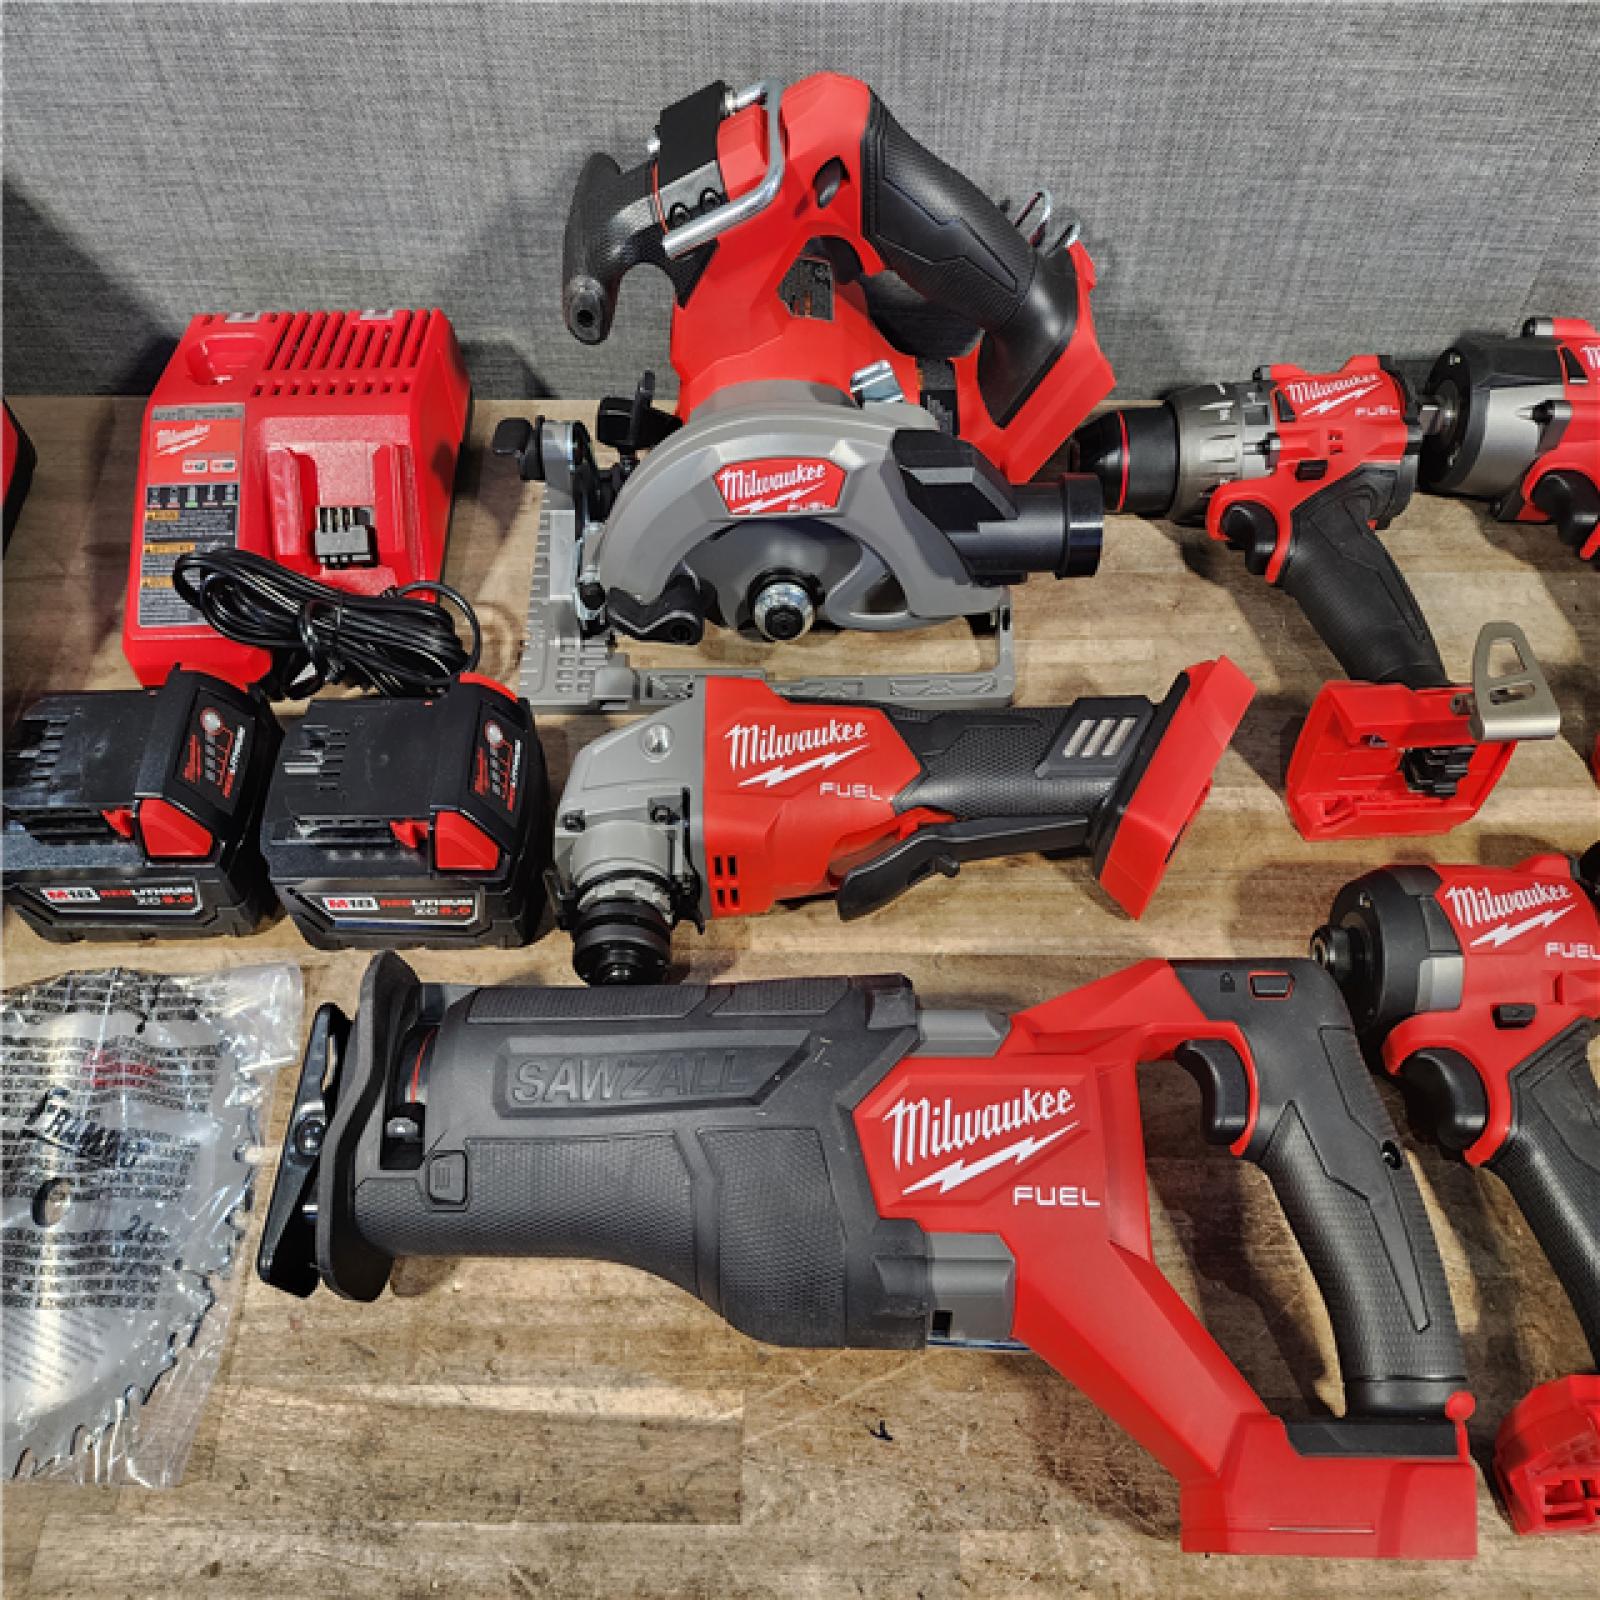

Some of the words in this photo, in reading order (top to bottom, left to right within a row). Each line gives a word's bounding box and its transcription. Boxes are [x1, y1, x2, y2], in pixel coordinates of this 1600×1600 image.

[1285, 373, 1380, 404] Milwaukee
[1354, 405, 1400, 416] FUEL
[719, 464, 826, 502] Milwaukee
[724, 718, 868, 771] Milwaukee
[818, 782, 884, 801] FUEL
[1445, 881, 1573, 929] Milwaukee
[1544, 942, 1600, 961] FUEL
[512, 1052, 750, 1103] SAWZALL
[883, 1087, 1076, 1172] Milwaukee
[1012, 1186, 1101, 1206] FUEL
